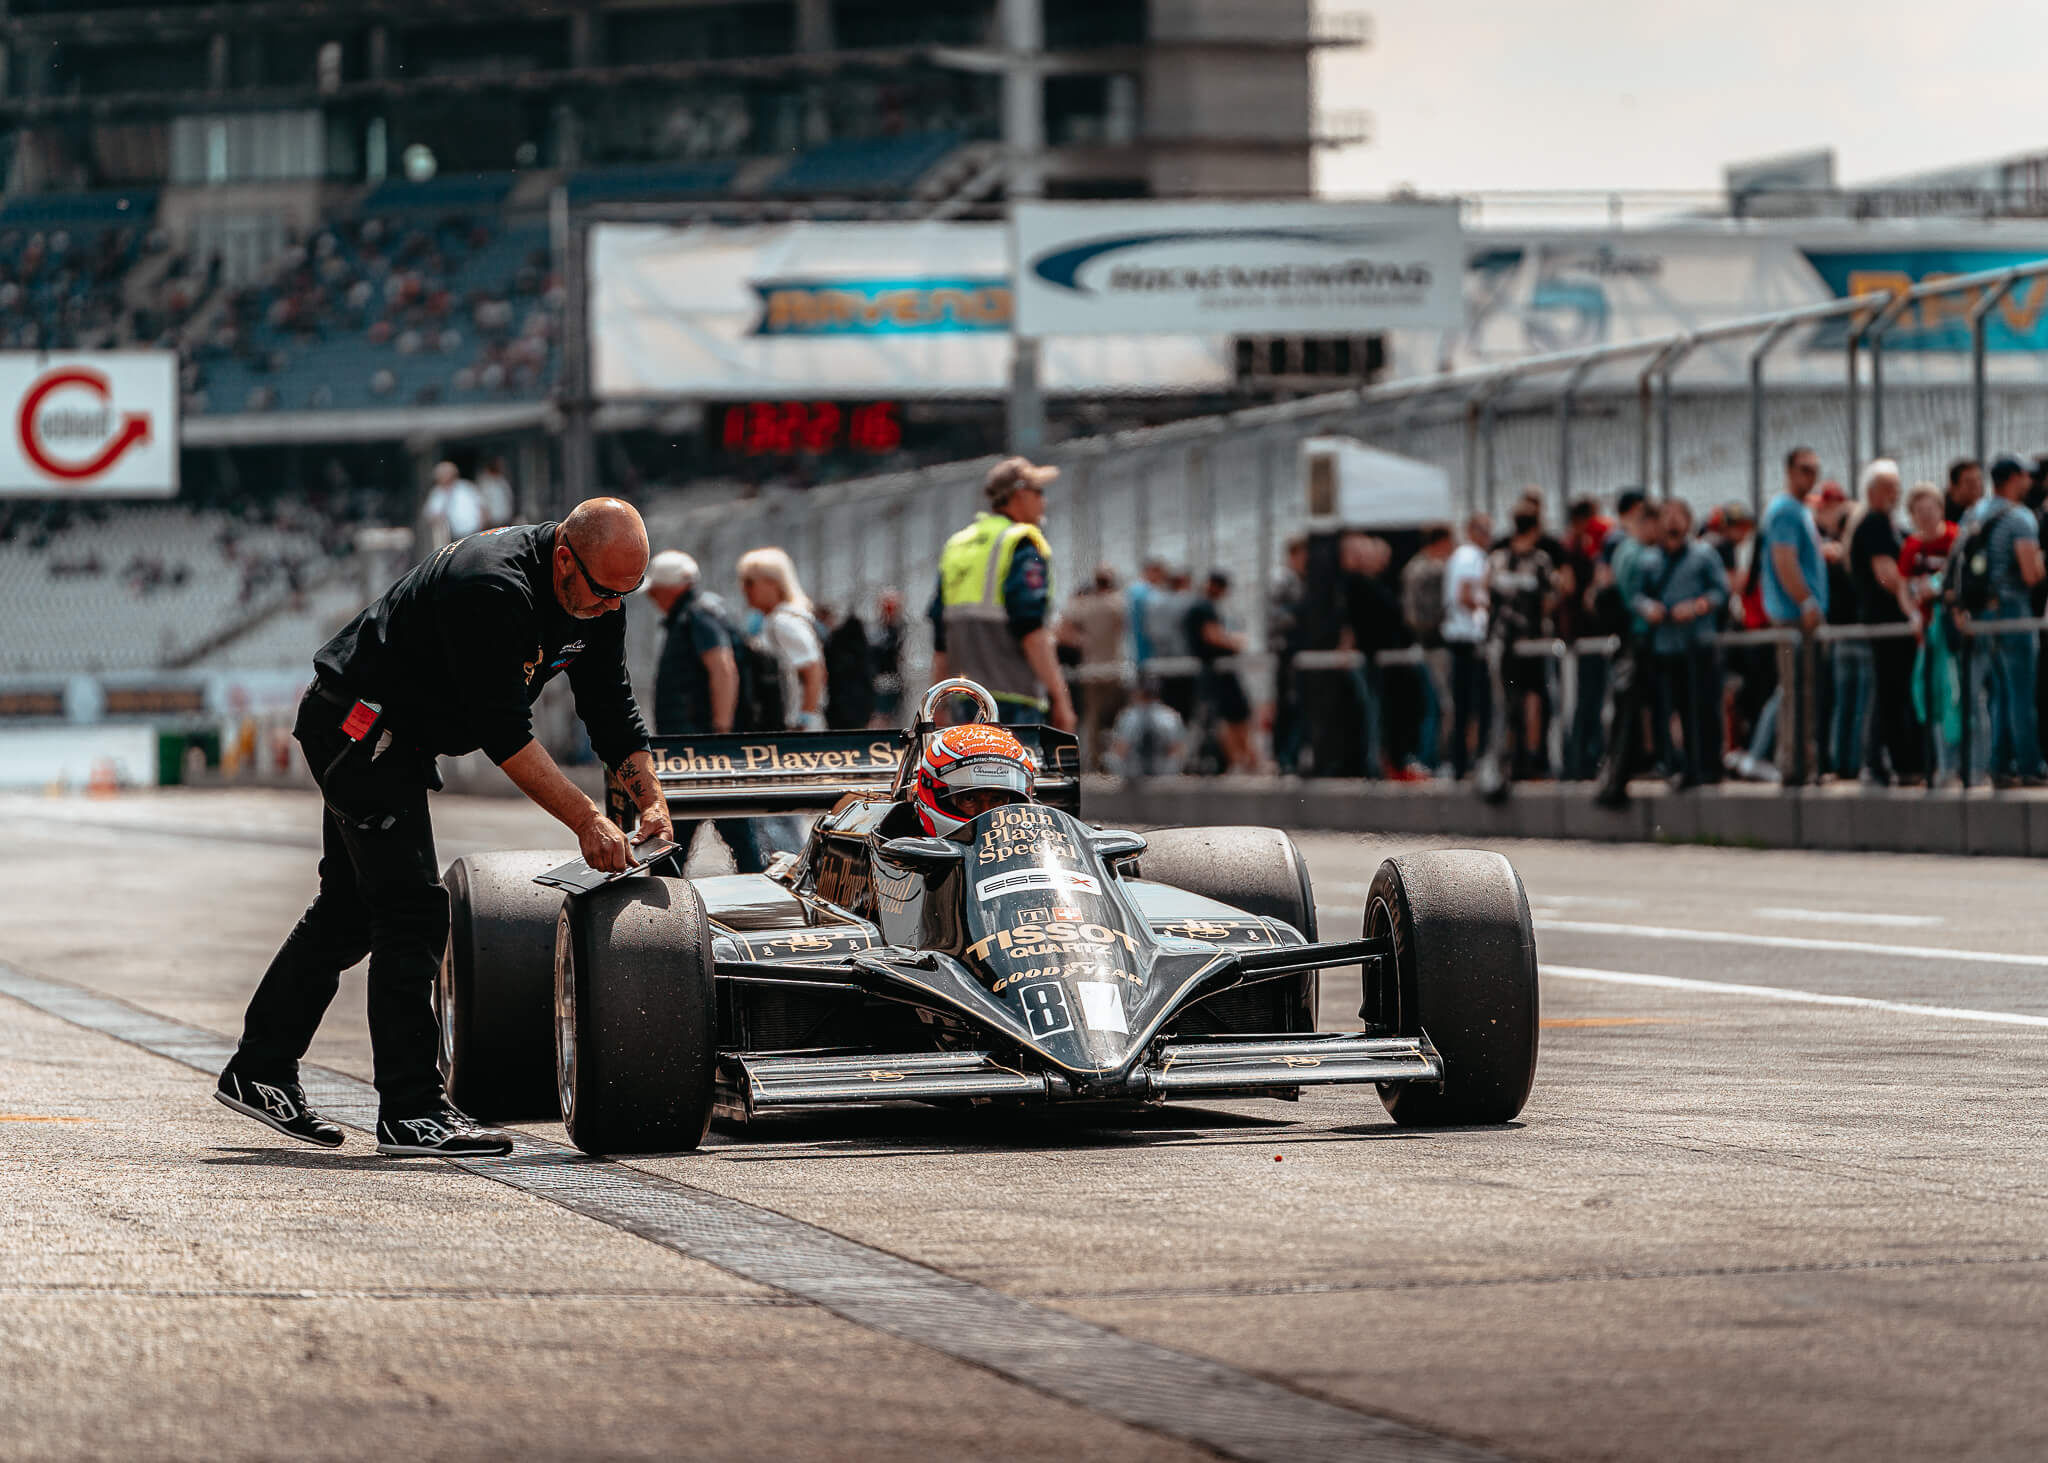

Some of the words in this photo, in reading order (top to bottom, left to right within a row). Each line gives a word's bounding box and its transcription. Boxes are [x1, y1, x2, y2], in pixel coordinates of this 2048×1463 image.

[652, 747, 733, 773] John
[741, 743, 861, 772] Player
[991, 808, 1056, 829] John
[981, 825, 1068, 847] Player
[978, 843, 1077, 866] Specal
[965, 922, 1141, 962] TISSOT
[1009, 943, 1113, 959] QUARTZ
[992, 961, 1144, 993] GOODYEAR
[1021, 982, 1072, 1037] 8
